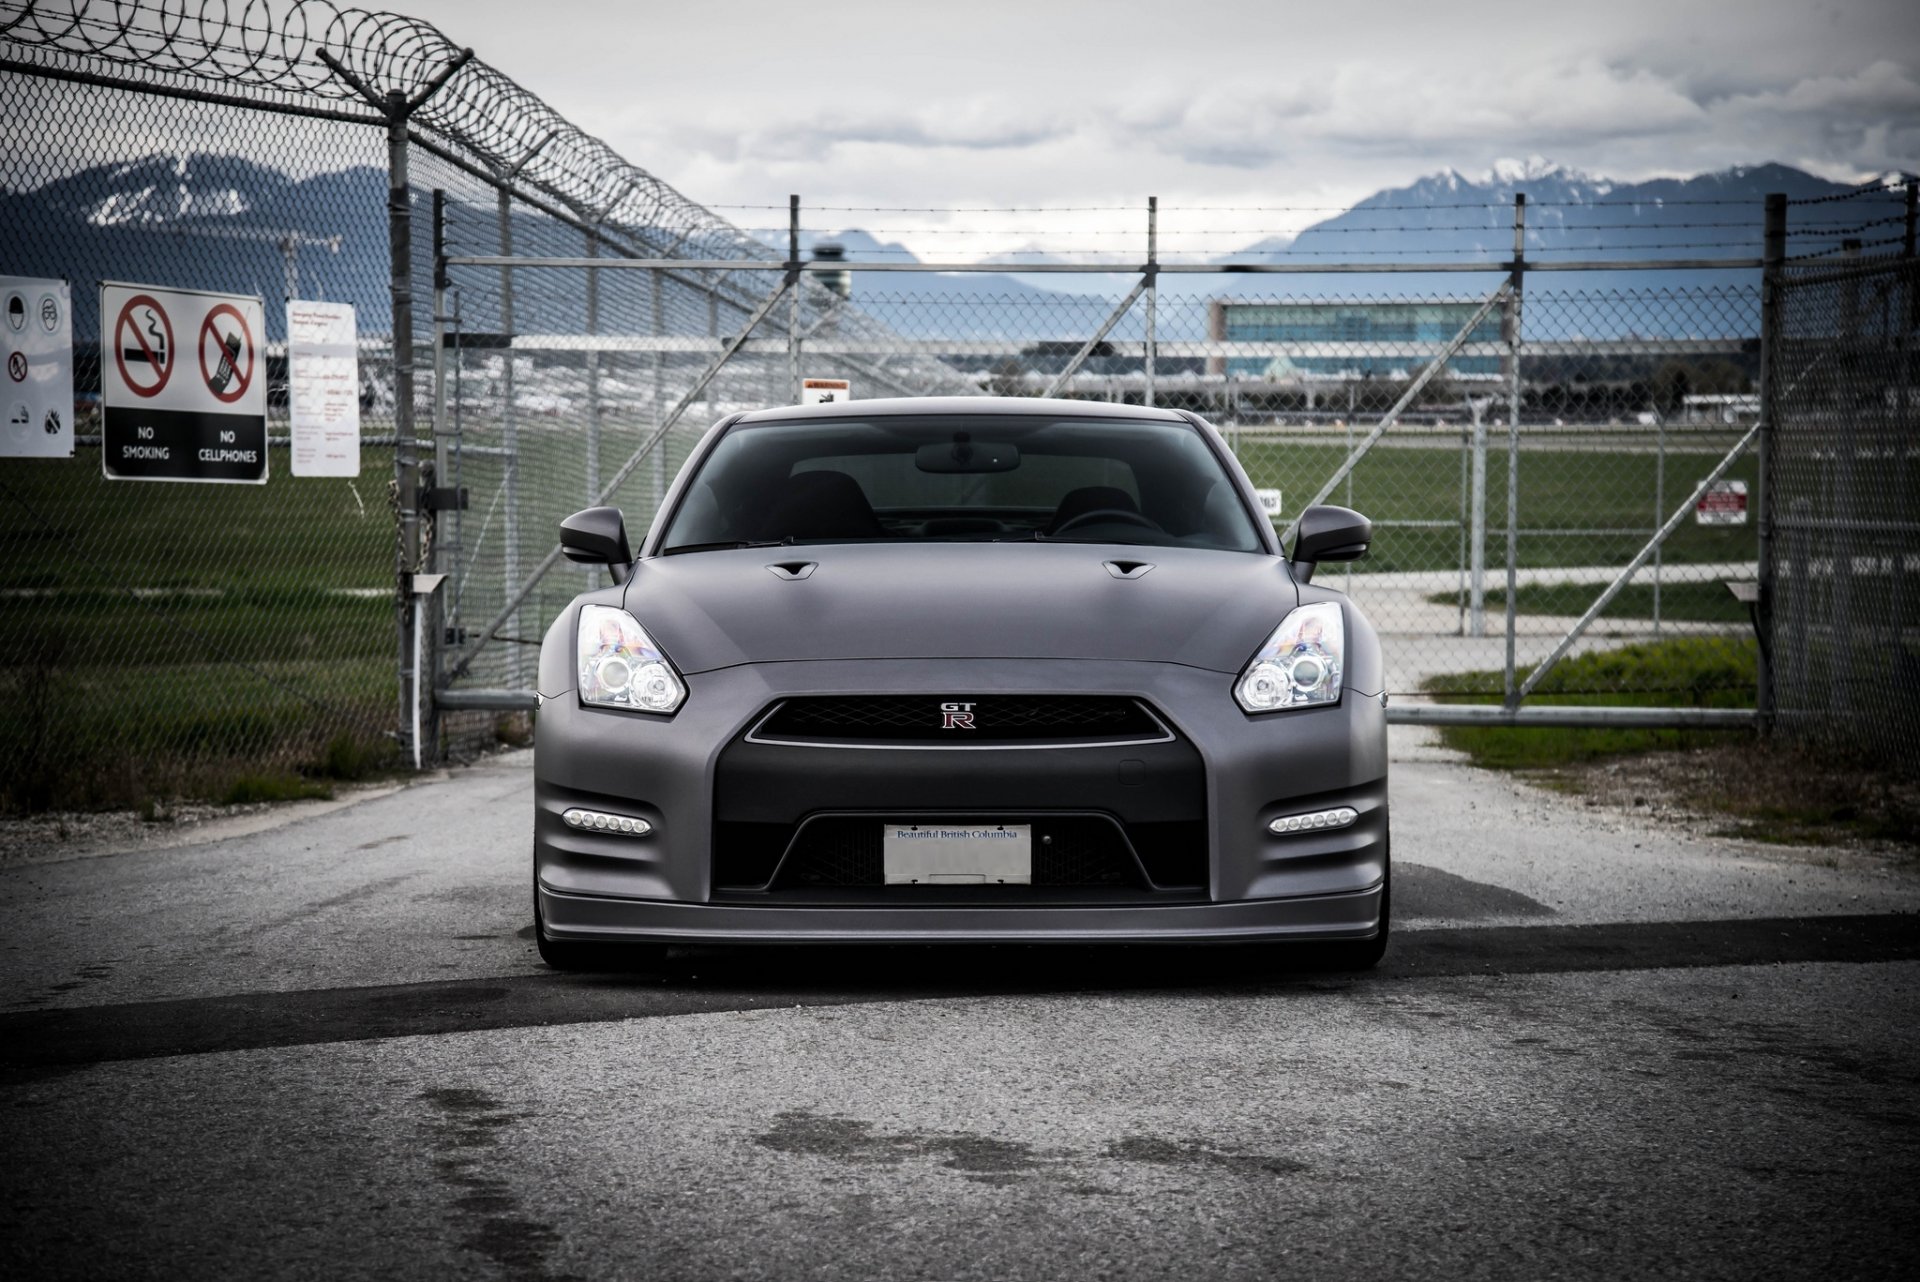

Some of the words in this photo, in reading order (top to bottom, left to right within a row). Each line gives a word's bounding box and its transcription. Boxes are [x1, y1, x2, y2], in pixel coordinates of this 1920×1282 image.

[137, 426, 154, 440] NO
[220, 430, 236, 444] NO
[122, 445, 170, 460] SMOKING
[198, 448, 258, 463] CELLPHONES
[940, 702, 977, 712] GT
[940, 711, 977, 729] R
[897, 830, 939, 839] Beautiful
[940, 830, 970, 839] British
[971, 830, 1017, 839] Columbia
